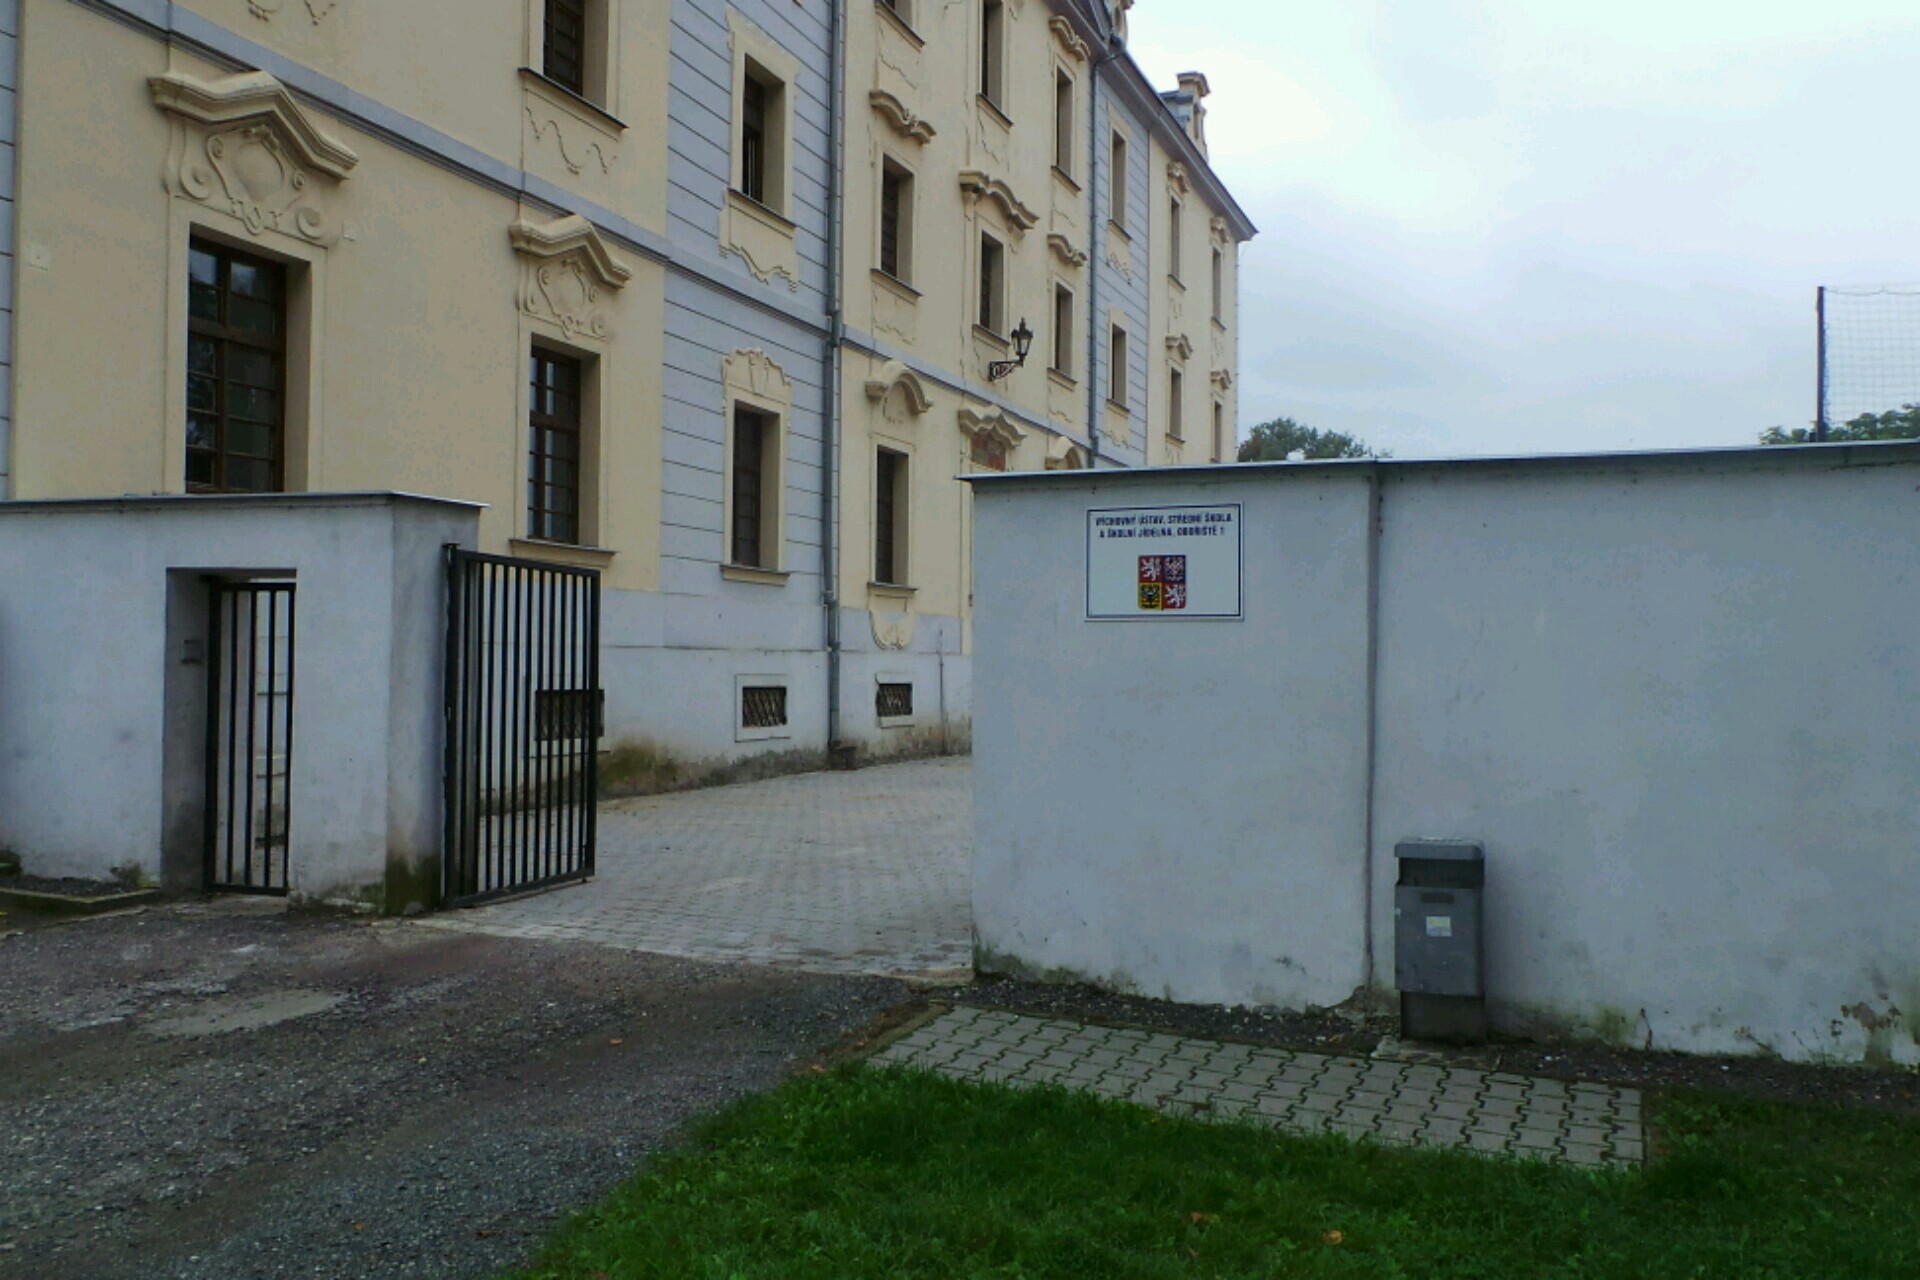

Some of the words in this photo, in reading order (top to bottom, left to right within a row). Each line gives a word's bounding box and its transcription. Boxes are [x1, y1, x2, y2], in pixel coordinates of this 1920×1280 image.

[1096, 515, 1136, 527] VÝCHOVNÝ
[1204, 512, 1232, 522] ŠKOLA
[1099, 529, 1105, 538] A
[1107, 528, 1136, 538] ŠKOLNÍ
